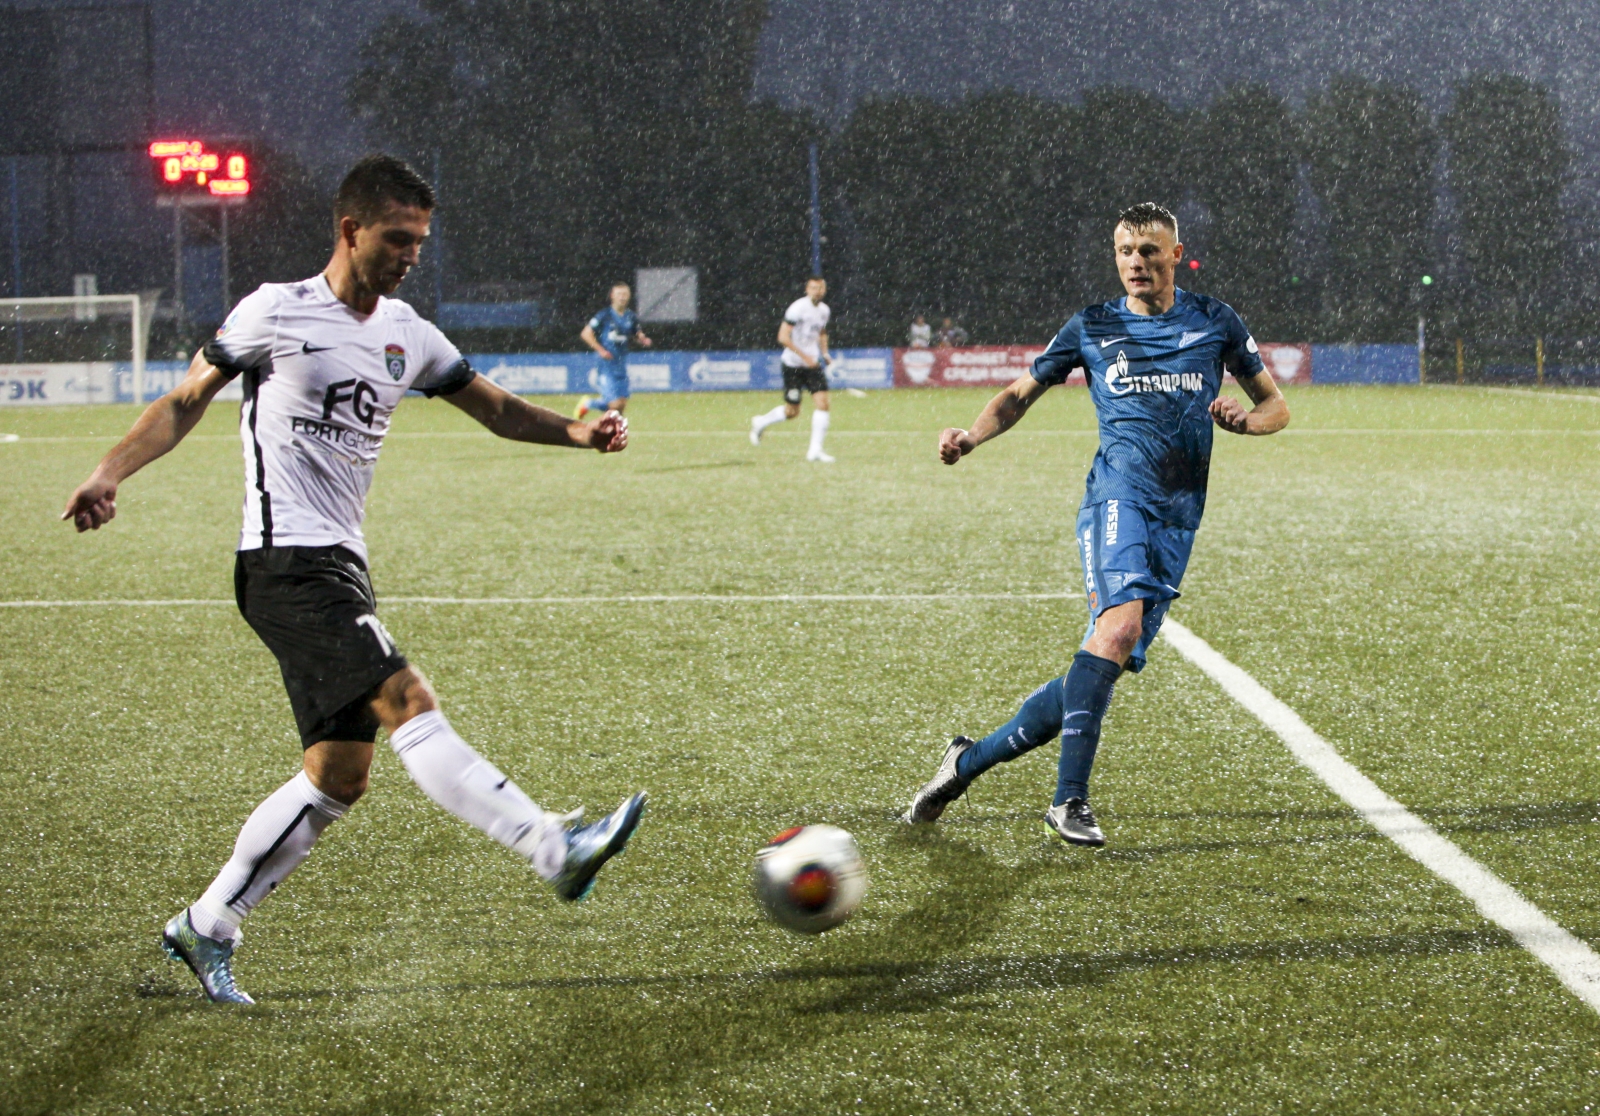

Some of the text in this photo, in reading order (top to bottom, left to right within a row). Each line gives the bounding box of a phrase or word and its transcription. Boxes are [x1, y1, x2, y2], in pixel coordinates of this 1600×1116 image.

[228, 156, 245, 179] 0
[321, 377, 380, 429] FG
[291, 416, 382, 452] FORTGR
